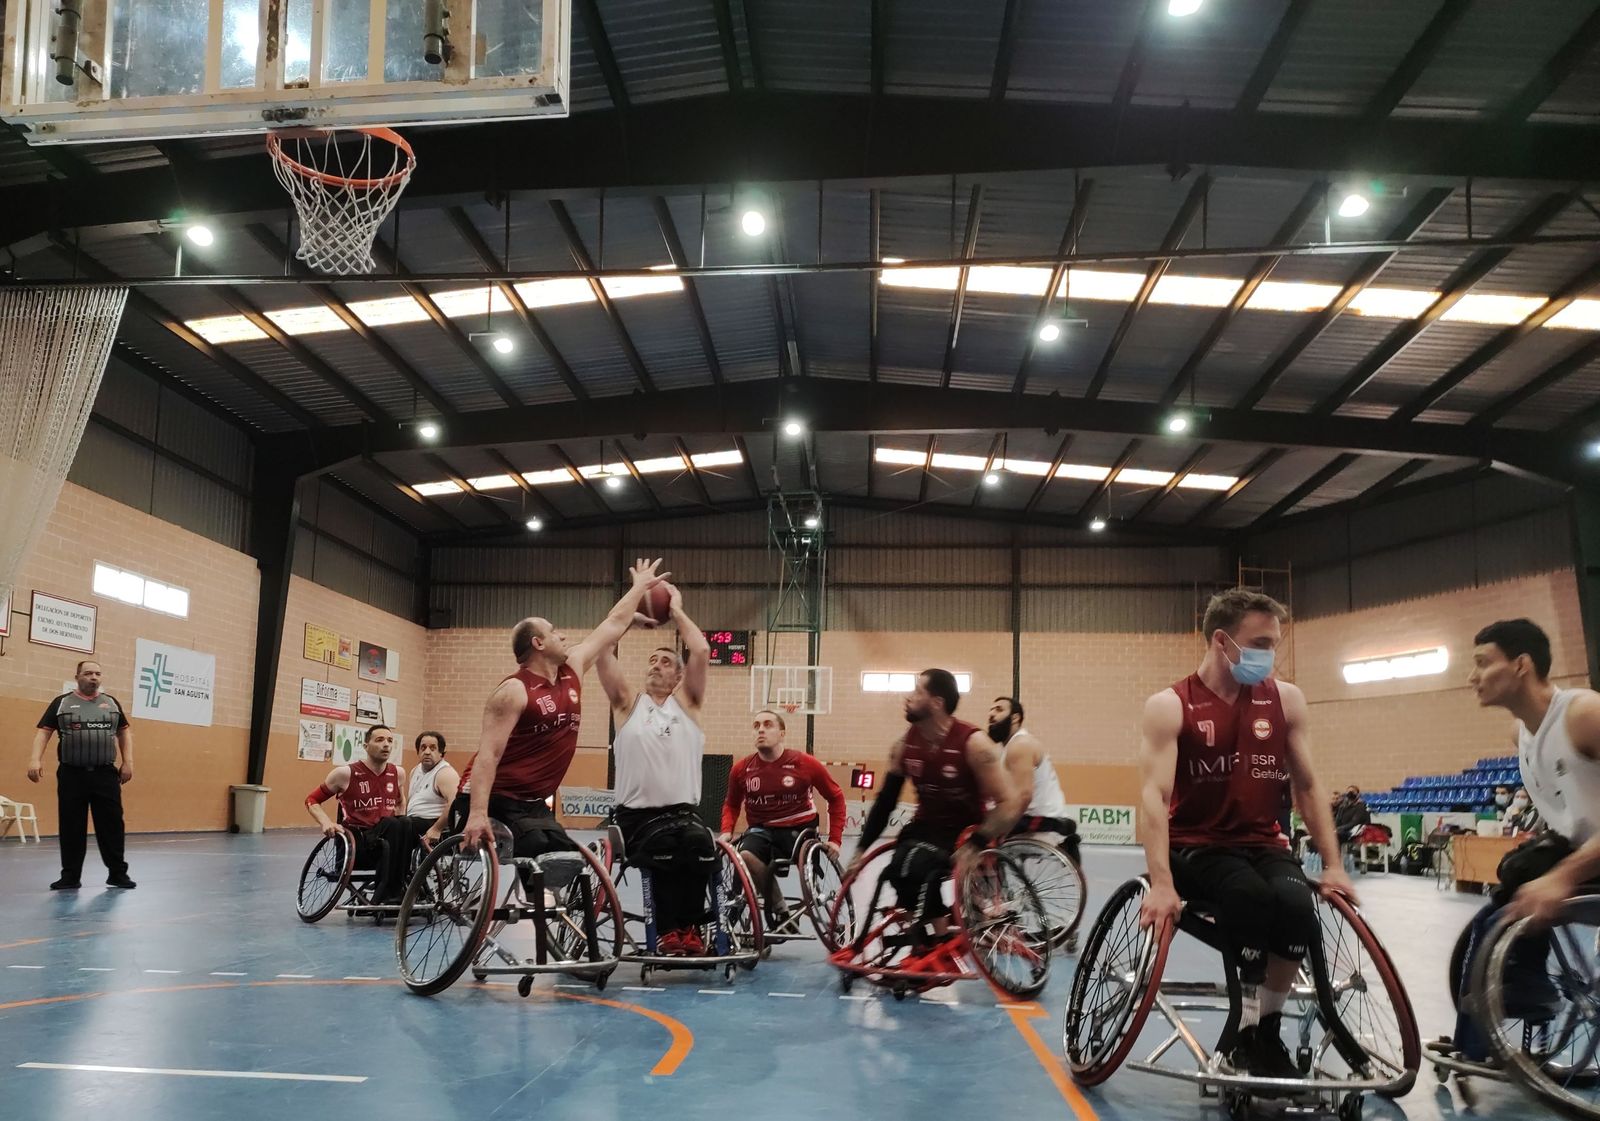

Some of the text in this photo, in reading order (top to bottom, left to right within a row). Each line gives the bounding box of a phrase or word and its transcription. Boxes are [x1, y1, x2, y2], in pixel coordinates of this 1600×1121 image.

[175, 673, 209, 687] HOSPITAL
[174, 687, 185, 696] SAN
[536, 694, 557, 715] 15
[1197, 719, 1216, 747] 7
[1251, 754, 1276, 766] BSR
[359, 781, 370, 794] 11
[745, 776, 761, 792] 10
[858, 774, 872, 788] 13
[353, 797, 383, 808] IMF
[561, 803, 581, 815] LOS
[1079, 807, 1131, 825] FABM
